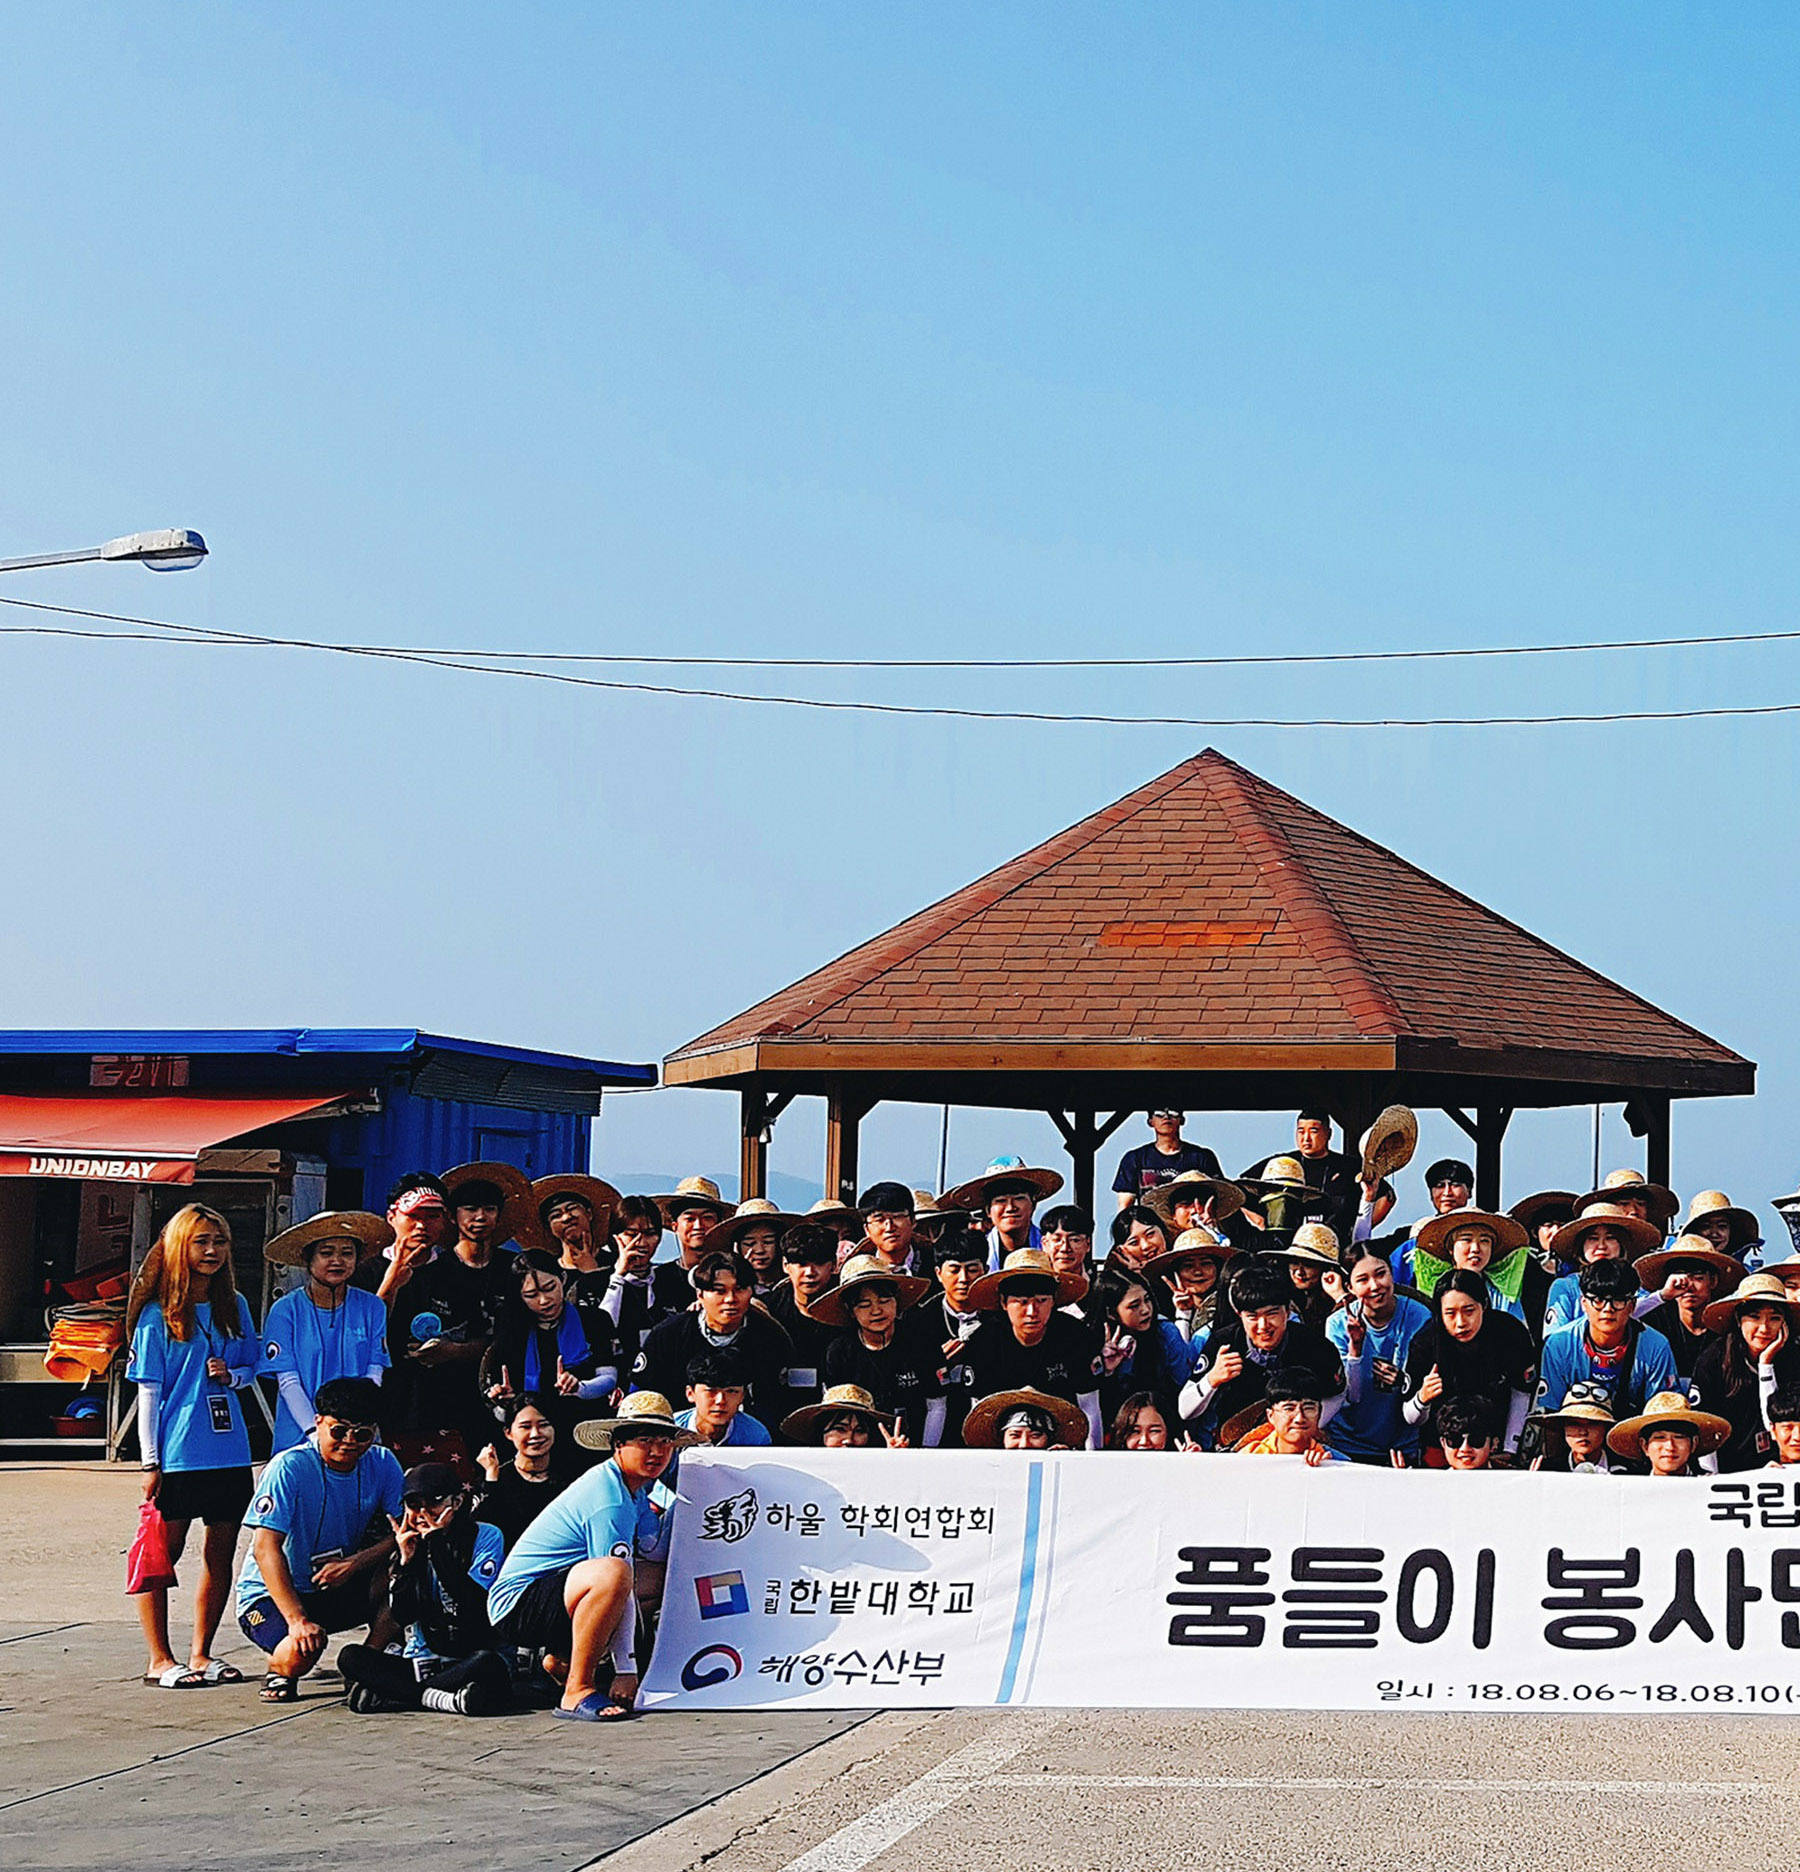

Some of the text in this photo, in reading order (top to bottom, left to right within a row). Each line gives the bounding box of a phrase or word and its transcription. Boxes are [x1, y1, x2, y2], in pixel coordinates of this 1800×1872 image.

[29, 1157, 157, 1179] UNIONBAY
[766, 1503, 994, 1539] 하울 학회연합회
[790, 1579, 975, 1616] 한밭대학교
[1166, 1546, 1496, 1650] 품들이
[757, 1649, 946, 1686] 해양수산부
[1376, 1680, 1434, 1702] 일시
